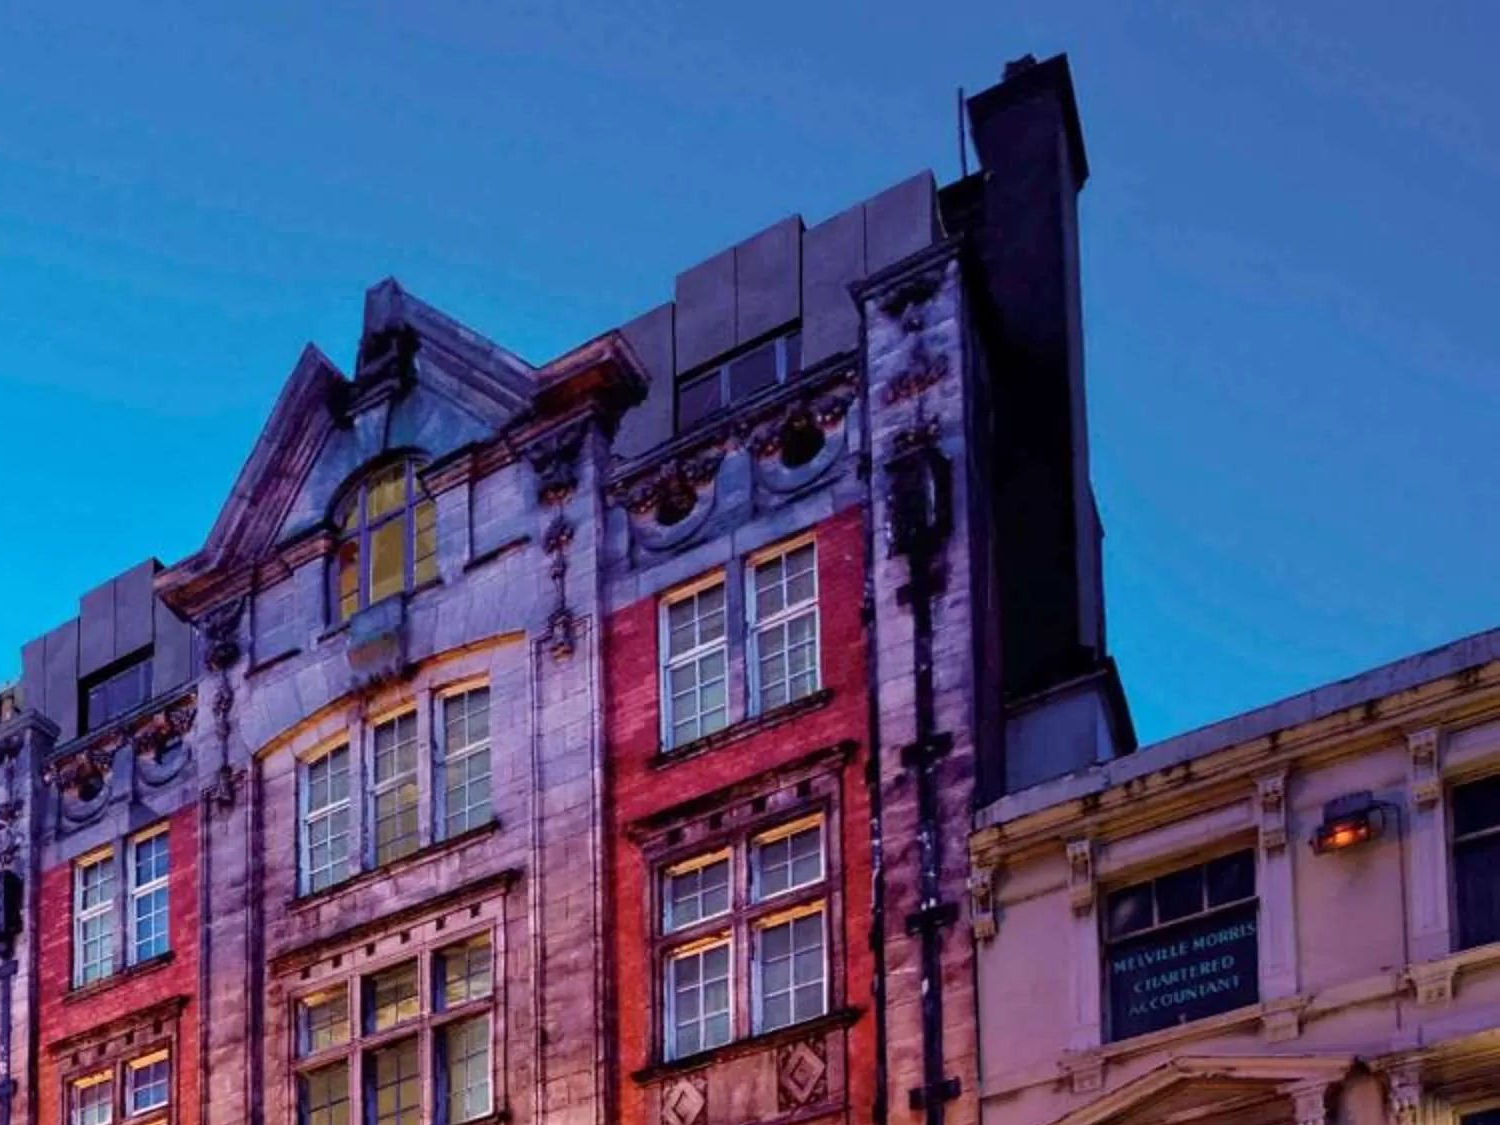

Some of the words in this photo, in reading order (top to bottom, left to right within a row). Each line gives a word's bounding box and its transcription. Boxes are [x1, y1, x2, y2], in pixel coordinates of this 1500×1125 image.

[1113, 941, 1189, 974] MELVILLE
[1192, 921, 1257, 950] MORRIS
[1133, 954, 1235, 993] CHARTERED
[1128, 976, 1239, 1016] ACCOUNTANT
